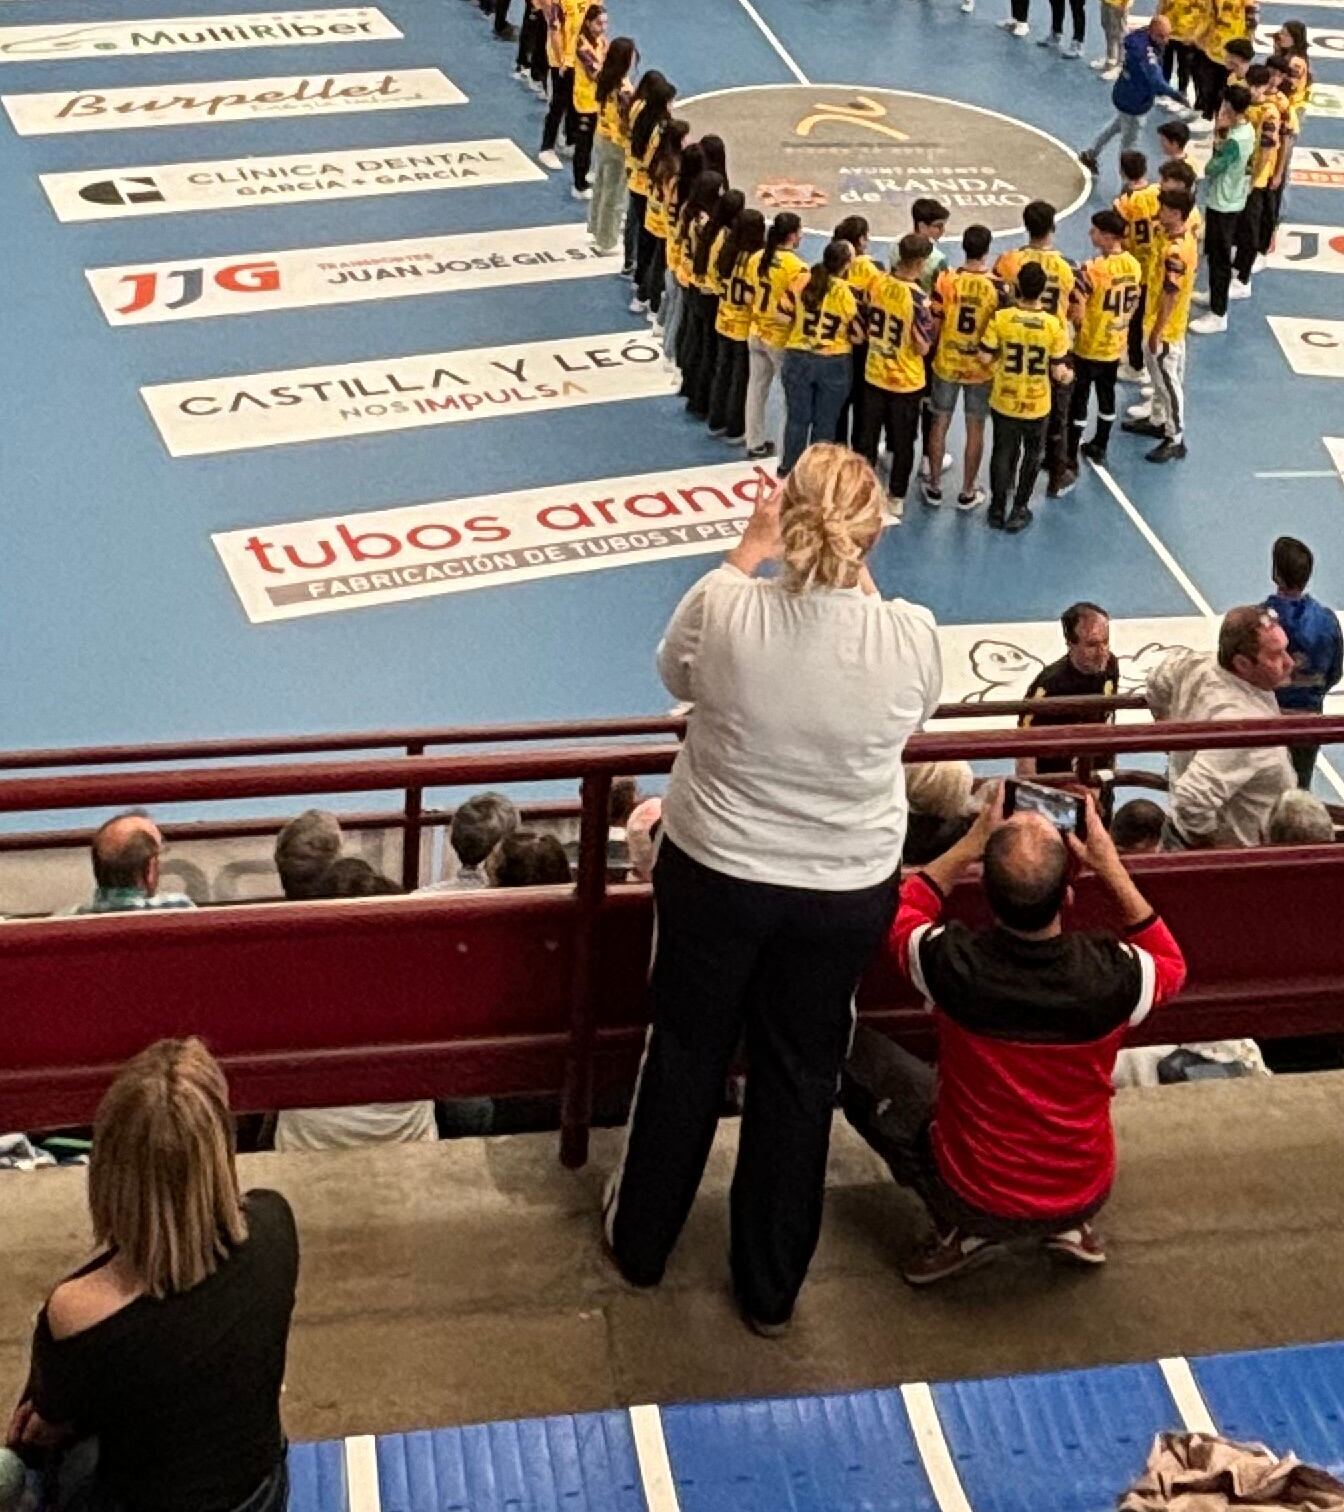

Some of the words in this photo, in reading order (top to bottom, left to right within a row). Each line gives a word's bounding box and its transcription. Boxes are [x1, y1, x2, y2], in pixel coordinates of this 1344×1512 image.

[130, 19, 374, 48] MultiRiber
[56, 74, 402, 119] Burpellet
[187, 159, 345, 185] CLÍNICA
[355, 151, 507, 172] DENTAL
[327, 264, 423, 285] JUAN
[427, 253, 511, 276] JOSÉ
[513, 249, 564, 266] GIL
[116, 260, 281, 315] JJG
[803, 312, 841, 341] 23
[957, 305, 977, 333] 6
[179, 368, 463, 417] CASTILLA
[492, 358, 531, 384] Y
[554, 338, 664, 373] LEÓ
[1004, 343, 1047, 375] 32
[339, 400, 409, 421] NOS
[412, 380, 588, 414] IMPULSA
[245, 514, 512, 575] tubos
[537, 466, 779, 532] arand
[307, 551, 517, 599] FABRICACIÓN
[521, 543, 564, 565] DE
[568, 529, 667, 558] TUBOS
[669, 526, 689, 543] Y
[693, 519, 750, 541] PER
